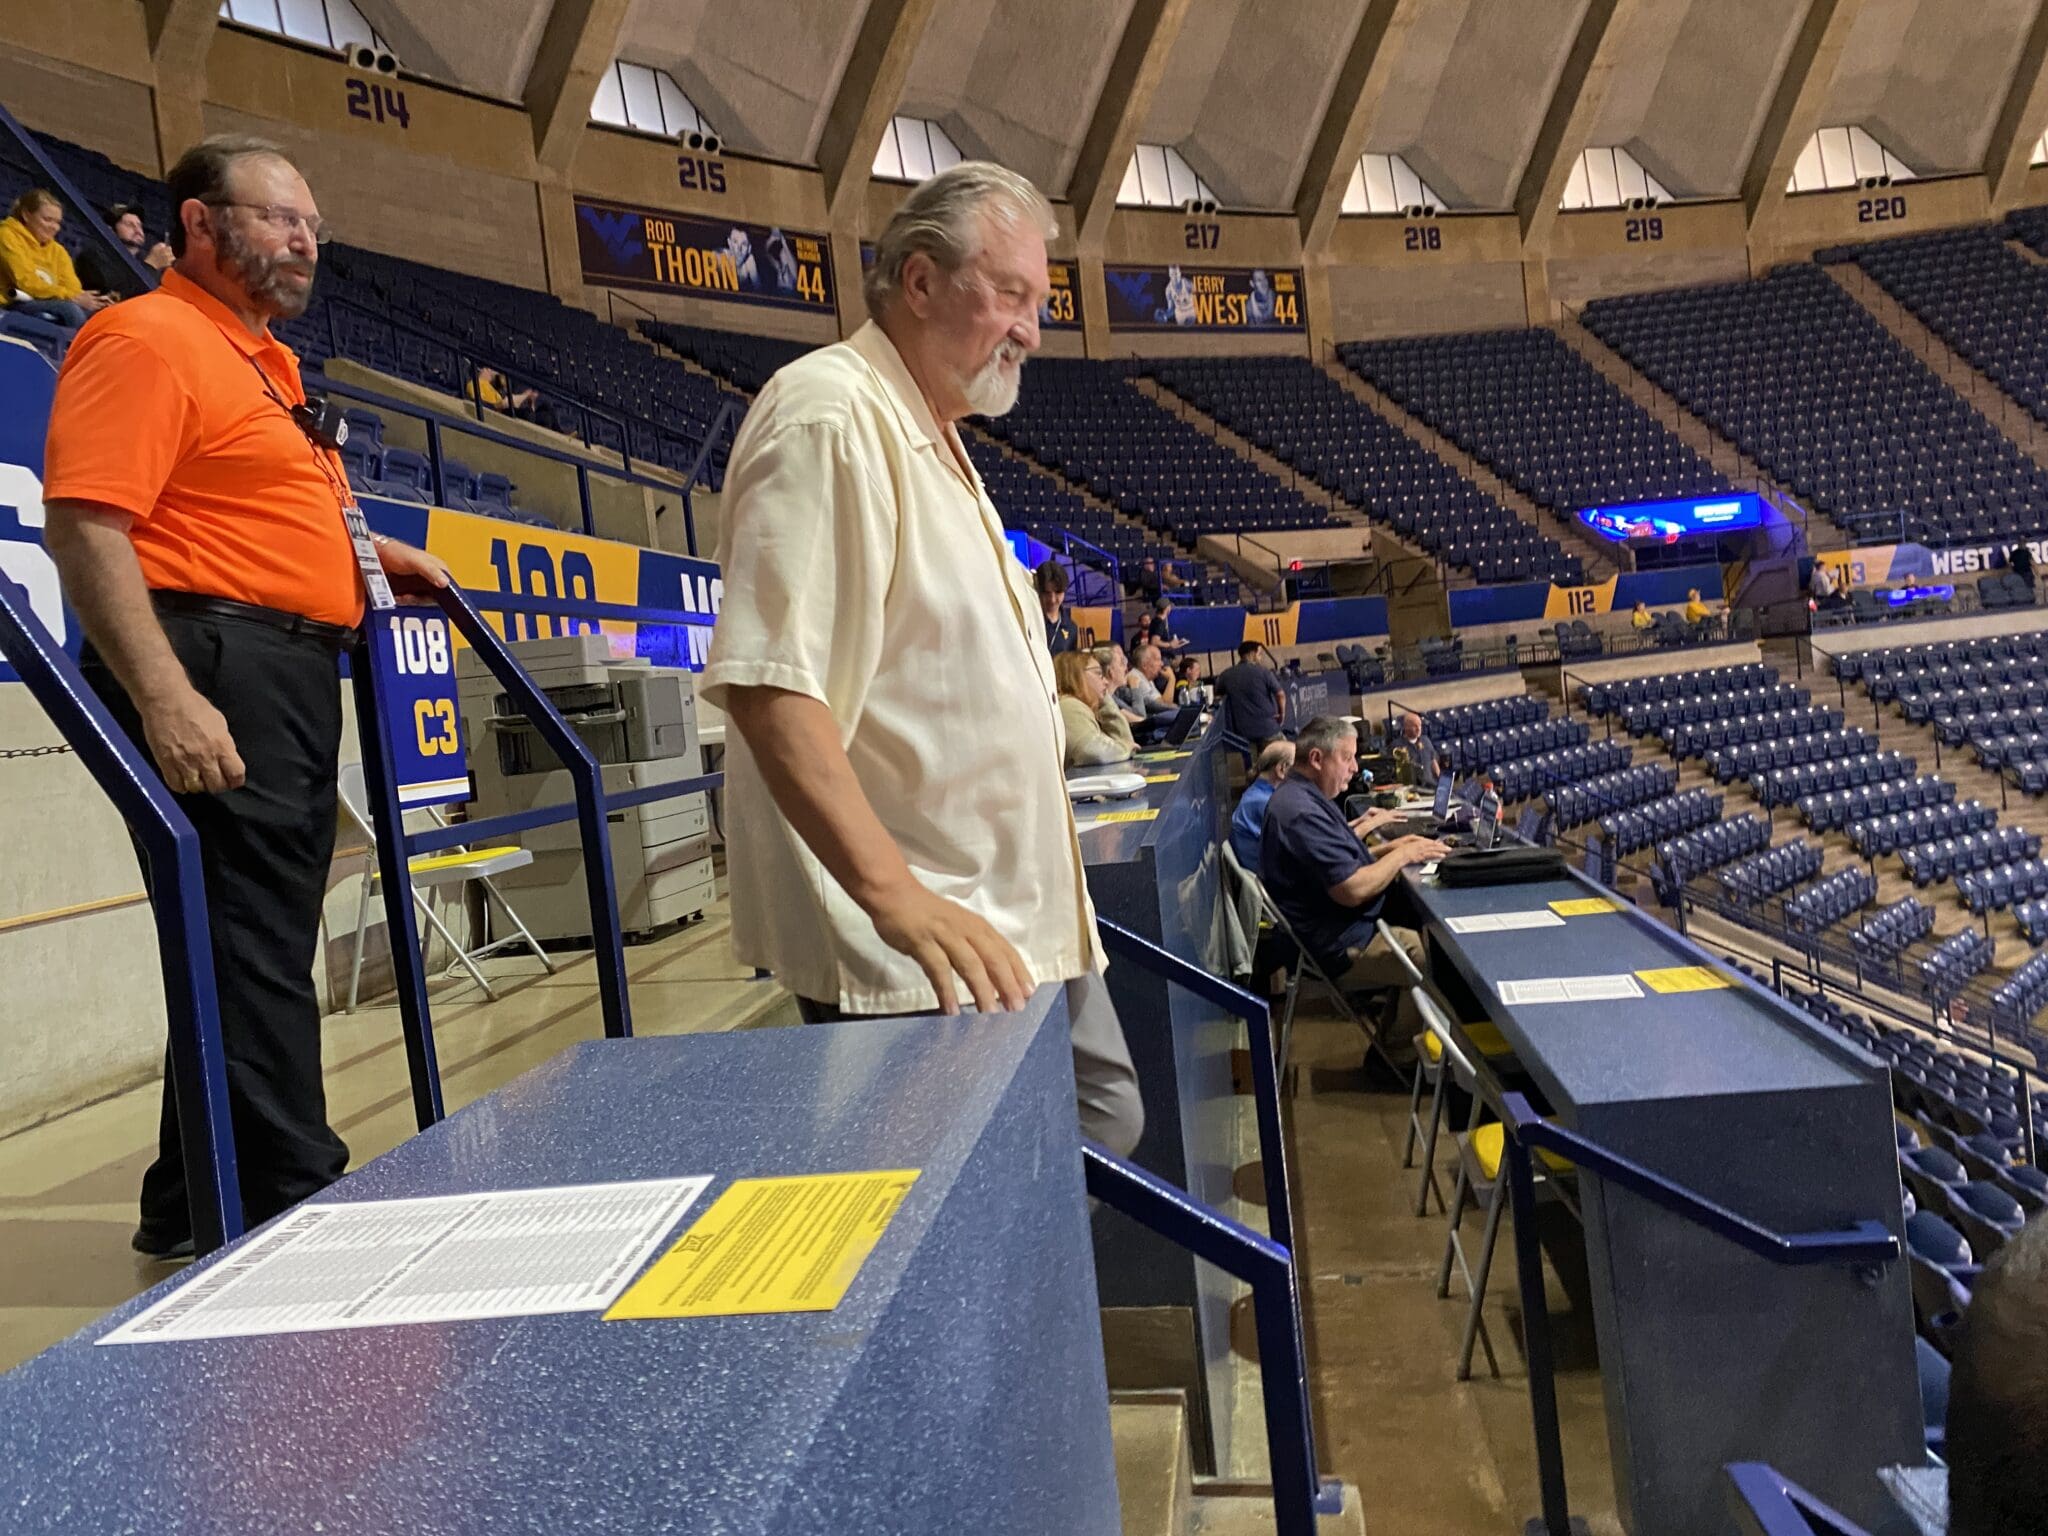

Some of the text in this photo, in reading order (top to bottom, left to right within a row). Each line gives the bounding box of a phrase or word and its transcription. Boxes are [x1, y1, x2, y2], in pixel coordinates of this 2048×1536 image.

[346, 79, 410, 129] 214
[678, 156, 726, 193] 215
[1858, 196, 1906, 222] 220
[645, 218, 676, 244] ROD
[1184, 223, 1220, 250] 217
[1405, 226, 1441, 250] 218
[1626, 218, 1663, 241] 219
[647, 241, 740, 292] THORN
[797, 264, 826, 304] 44
[1192, 275, 1225, 294] JERRY
[1049, 288, 1075, 321] 33
[1192, 293, 1249, 325] WEST
[1274, 294, 1298, 325] 44
[1835, 562, 1867, 587] 113
[1931, 546, 1993, 576] WEST
[490, 537, 601, 642] 108
[1567, 589, 1597, 614] 112
[390, 616, 449, 674] 108
[1263, 617, 1281, 646] 111
[413, 698, 459, 757] C3
